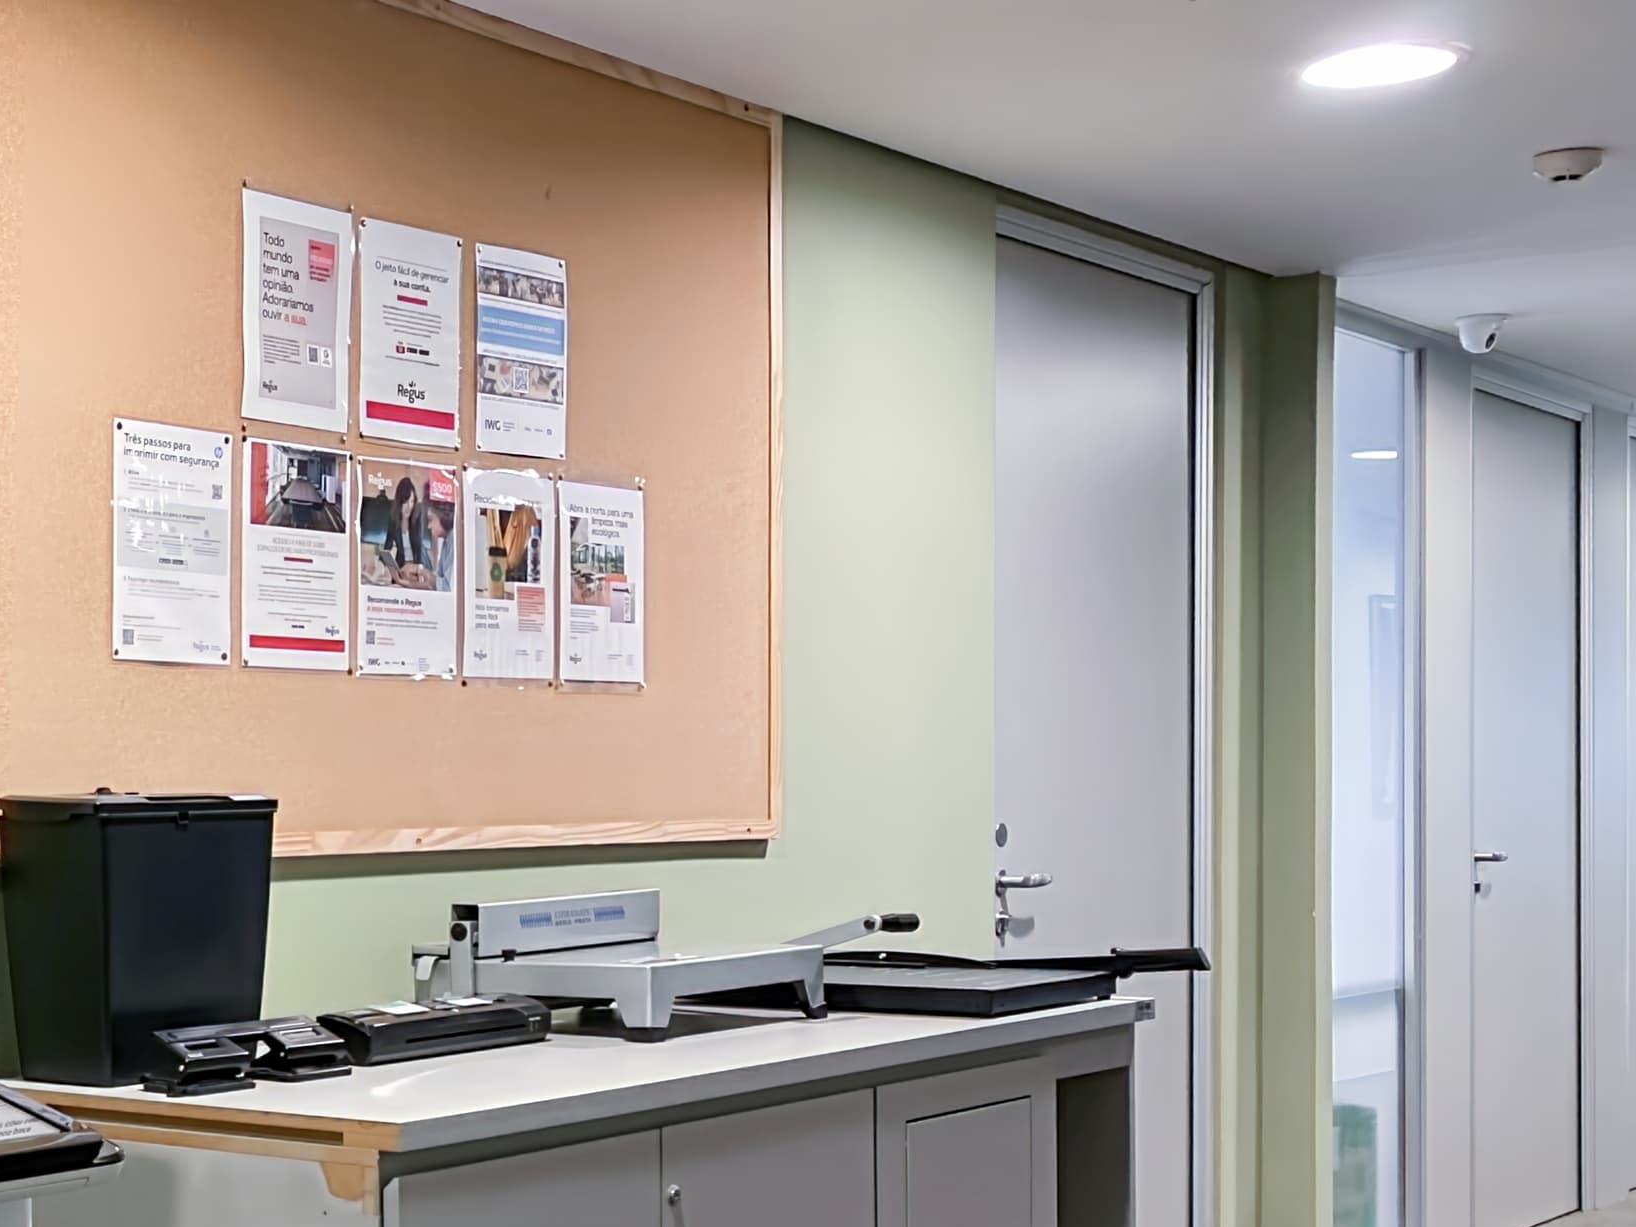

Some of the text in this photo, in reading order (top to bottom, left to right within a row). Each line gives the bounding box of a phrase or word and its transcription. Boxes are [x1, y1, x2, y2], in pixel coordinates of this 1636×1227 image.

[263, 231, 285, 248] Todo
[263, 249, 293, 264] mundo
[375, 260, 382, 270] O
[263, 263, 300, 281] tem uma
[262, 309, 283, 321] ouvir
[397, 382, 426, 404] Regus
[484, 418, 501, 431] IWG
[123, 432, 192, 452] Três passos para
[159, 452, 178, 462] com
[179, 455, 220, 471] segurança
